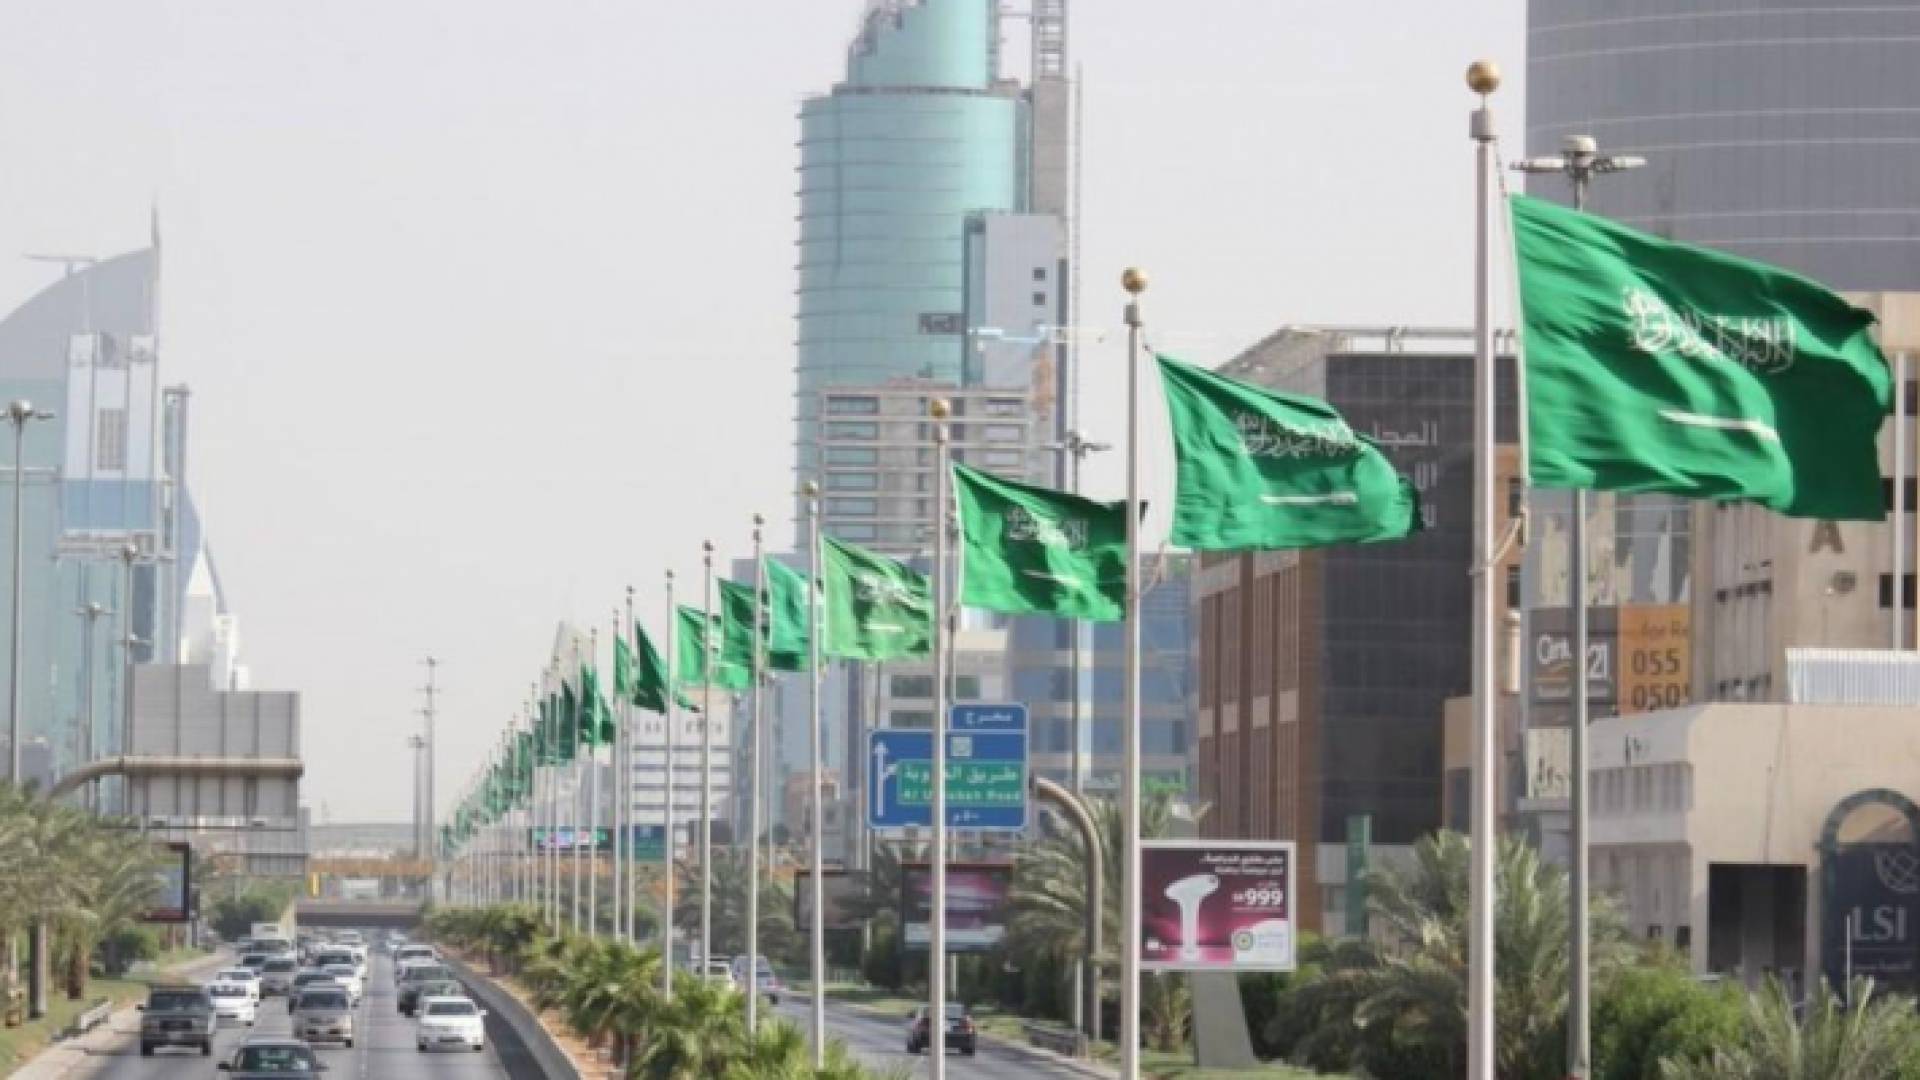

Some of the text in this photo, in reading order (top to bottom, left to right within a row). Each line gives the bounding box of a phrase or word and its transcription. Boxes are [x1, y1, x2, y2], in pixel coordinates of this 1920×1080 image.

[1632, 648, 1680, 675] 055
[966, 766, 1017, 785] طريق
[1245, 888, 1283, 905] 999
